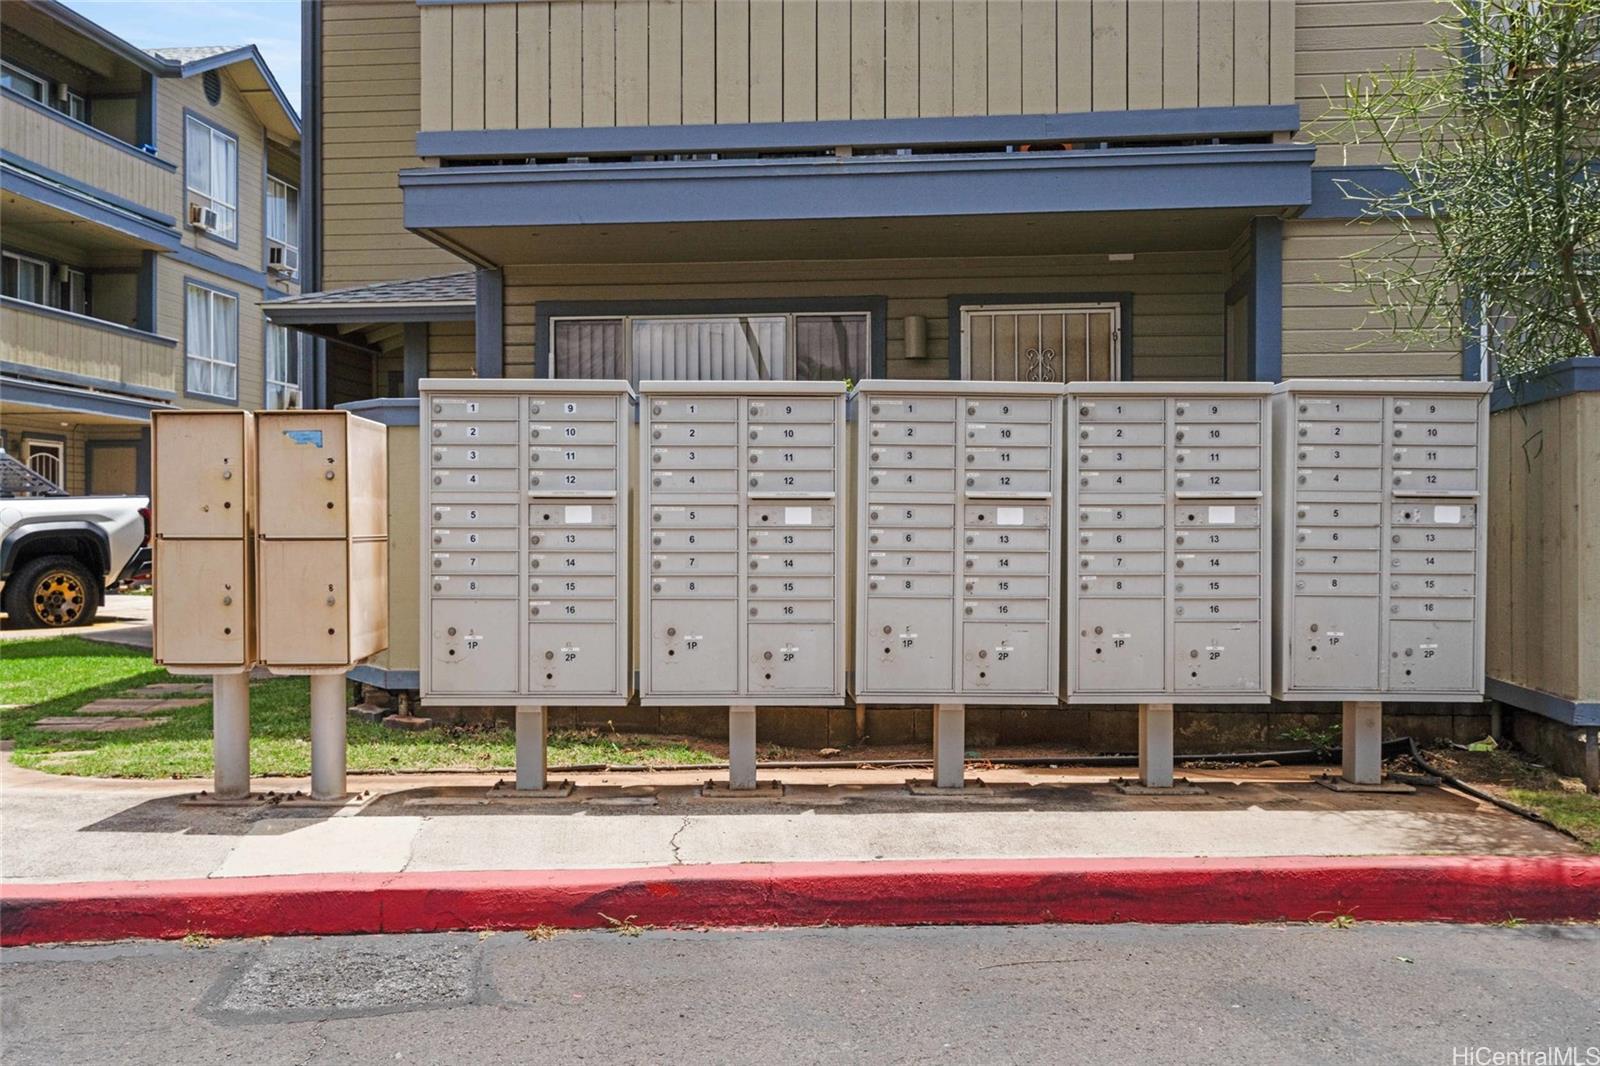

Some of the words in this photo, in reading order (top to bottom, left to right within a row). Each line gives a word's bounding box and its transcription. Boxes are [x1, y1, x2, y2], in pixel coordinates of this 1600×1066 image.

[567, 404, 574, 413] 9
[785, 406, 792, 414] 9
[1002, 406, 1009, 415] 9
[1211, 406, 1218, 415] 9
[1429, 405, 1436, 414] 9
[470, 427, 476, 436] 2
[566, 428, 576, 436] 10
[689, 429, 695, 438] 2
[783, 429, 794, 438] 10
[907, 428, 913, 437] 2
[1000, 429, 1011, 438] 10
[1116, 429, 1123, 438] 2
[1210, 430, 1220, 438] 10
[1334, 427, 1341, 436] 2
[1427, 428, 1438, 437] 10
[470, 450, 477, 460] 3
[566, 452, 575, 460] 11
[689, 451, 696, 460] 3
[784, 453, 793, 462] 11
[907, 451, 913, 460] 3
[1001, 453, 1010, 462] 11
[1116, 452, 1123, 461] 3
[1210, 453, 1219, 461] 11
[1334, 450, 1340, 459] 3
[1427, 452, 1437, 460] 11
[470, 475, 476, 483] 4
[566, 475, 576, 484] 12
[689, 476, 695, 484] 4
[784, 476, 794, 485] 12
[906, 475, 913, 483] 4
[1000, 476, 1010, 485] 12
[1116, 476, 1122, 484] 4
[1210, 476, 1220, 485] 12
[1333, 474, 1340, 482] 4
[1426, 475, 1437, 484] 12
[470, 510, 477, 519] 5
[689, 511, 696, 520] 5
[906, 510, 913, 519] 5
[1116, 511, 1123, 520] 5
[1333, 509, 1339, 518] 5
[470, 534, 476, 543] 6
[566, 534, 576, 543] 13
[689, 535, 695, 544] 6
[783, 535, 794, 544] 13
[905, 534, 912, 543] 6
[999, 535, 1010, 544] 13
[1116, 534, 1122, 544] 6
[1209, 534, 1220, 543] 13
[1332, 532, 1339, 541] 6
[1425, 533, 1436, 542] 13
[470, 558, 476, 566] 7
[689, 557, 695, 566] 7
[783, 559, 794, 567] 14
[906, 557, 912, 565] 7
[999, 559, 1009, 567] 14
[1117, 558, 1123, 566] 7
[1210, 559, 1220, 567] 14
[1332, 555, 1338, 564] 7
[470, 581, 476, 591] 8
[565, 582, 576, 591] 15
[689, 582, 695, 591] 8
[783, 582, 794, 591] 15
[905, 580, 912, 589] 8
[998, 582, 1009, 591] 15
[1116, 581, 1122, 590] 8
[1209, 582, 1220, 590] 15
[1331, 579, 1338, 588] 8
[1424, 580, 1435, 589] 15
[565, 605, 576, 614] 16
[783, 606, 794, 615] 16
[999, 605, 1009, 614] 16
[1209, 605, 1220, 614] 16
[1424, 603, 1434, 612] 16
[468, 641, 479, 649] 1P
[687, 641, 698, 650] 1P
[902, 639, 913, 648] 1P
[1114, 639, 1125, 648] 1P
[1329, 637, 1340, 646] 1P
[565, 653, 576, 662] 2P
[783, 653, 795, 662] 2P
[998, 652, 1009, 661] 2P
[1209, 651, 1221, 660] 2P
[1424, 650, 1435, 659] 2P
